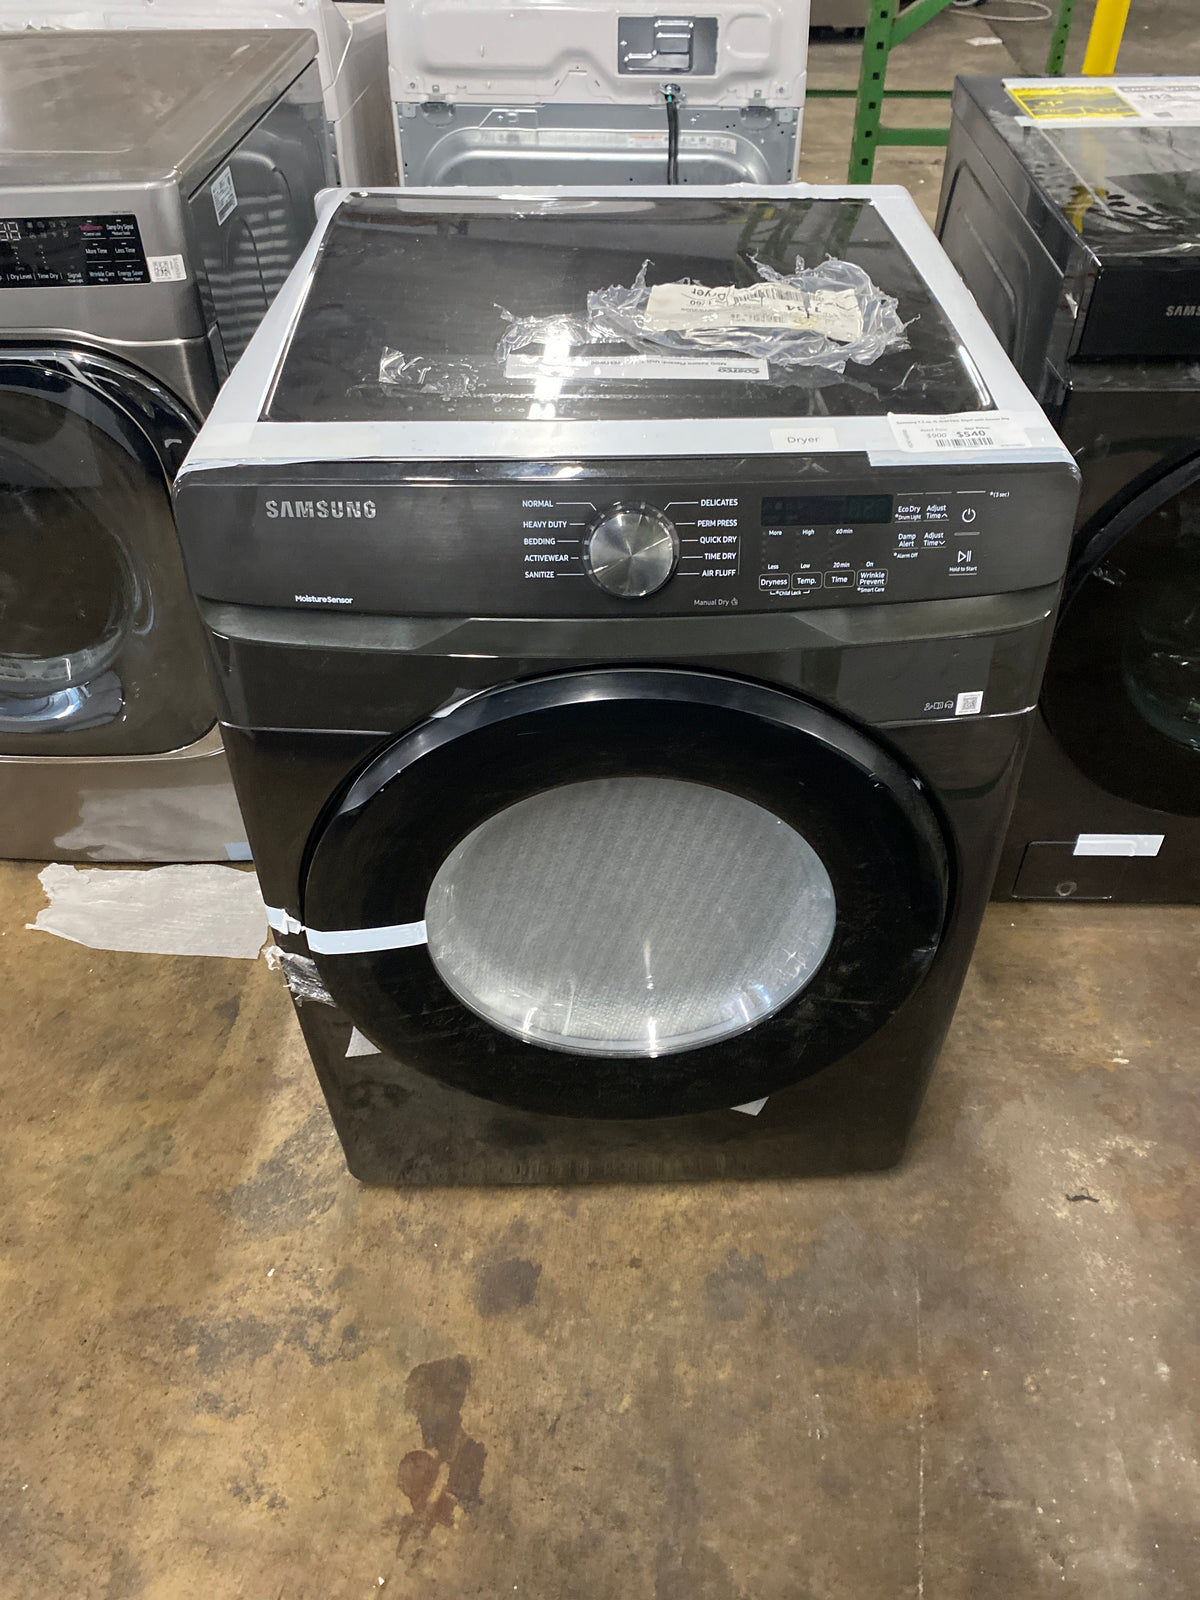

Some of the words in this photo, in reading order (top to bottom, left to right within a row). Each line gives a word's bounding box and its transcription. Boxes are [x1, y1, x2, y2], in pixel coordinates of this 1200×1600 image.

[50, 272, 59, 280] Dry
[691, 288, 726, 301] Dryer
[955, 430, 986, 438] $540
[787, 435, 820, 445] Dryer
[522, 500, 554, 508] NORMAL
[700, 498, 739, 507] DELICATES
[265, 500, 377, 519] SAMSUNG
[898, 505, 910, 513] Eco
[910, 505, 921, 513] Dry
[926, 504, 947, 512] Adjust
[522, 521, 547, 529] HEAVY
[548, 520, 567, 528] DUTY
[697, 520, 716, 528] PERM
[717, 519, 738, 527] PRESS
[699, 536, 722, 545] QUICK
[722, 535, 737, 543] DRY
[898, 533, 916, 541] Damp
[924, 532, 944, 540] Adjust
[523, 537, 556, 545] BEDDING
[524, 554, 569, 562] ACTIVEWEAR
[704, 552, 721, 560] TIME
[722, 552, 737, 560] DRY
[524, 571, 555, 579] SANITIZE
[702, 569, 714, 577] AIR
[715, 569, 737, 577] FLUFF
[860, 571, 885, 579] Wrinkle
[760, 578, 788, 587] Dryness
[797, 577, 817, 585] Temp.
[295, 594, 354, 604] MoistureSensor
[693, 598, 717, 606] Manual
[718, 598, 729, 607] Dry
